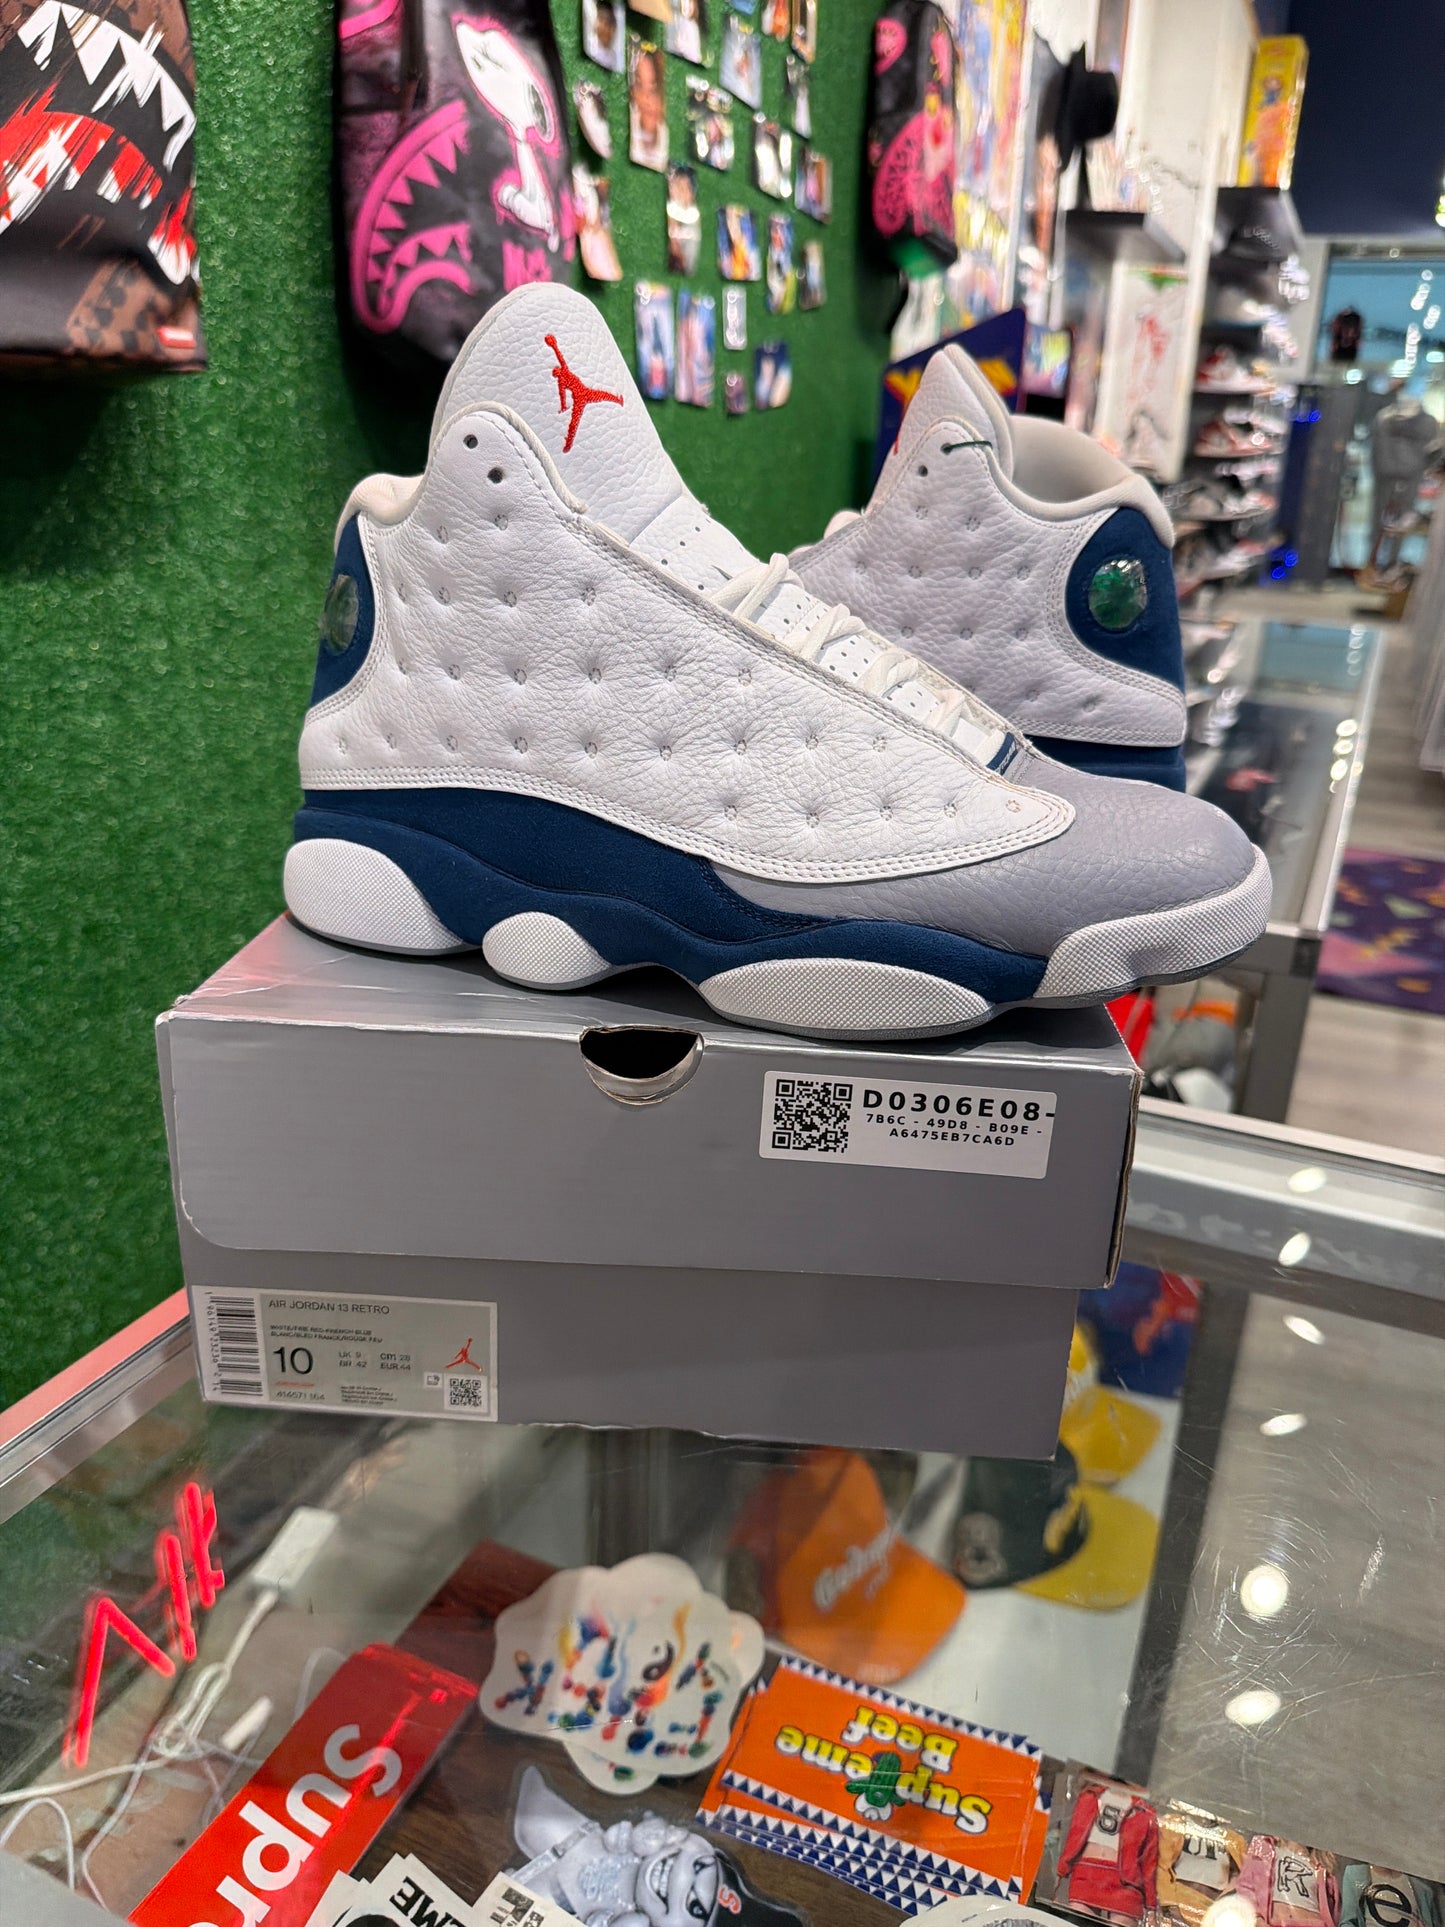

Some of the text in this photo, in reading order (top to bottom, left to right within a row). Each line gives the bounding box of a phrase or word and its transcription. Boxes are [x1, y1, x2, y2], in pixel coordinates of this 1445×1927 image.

[862, 1089, 1056, 1121] D0306E08-
[889, 1127, 1016, 1147] A6475EB7CA6D
[268, 1299, 390, 1315] AIR JORDAN 13 RETRO
[272, 1346, 314, 1375] 10
[356, 1361, 368, 1369] 42
[380, 1362, 399, 1370] EUR
[841, 1705, 958, 1774] Beef
[775, 1725, 992, 1835] Supeme
[187, 1723, 402, 1927] Supr
